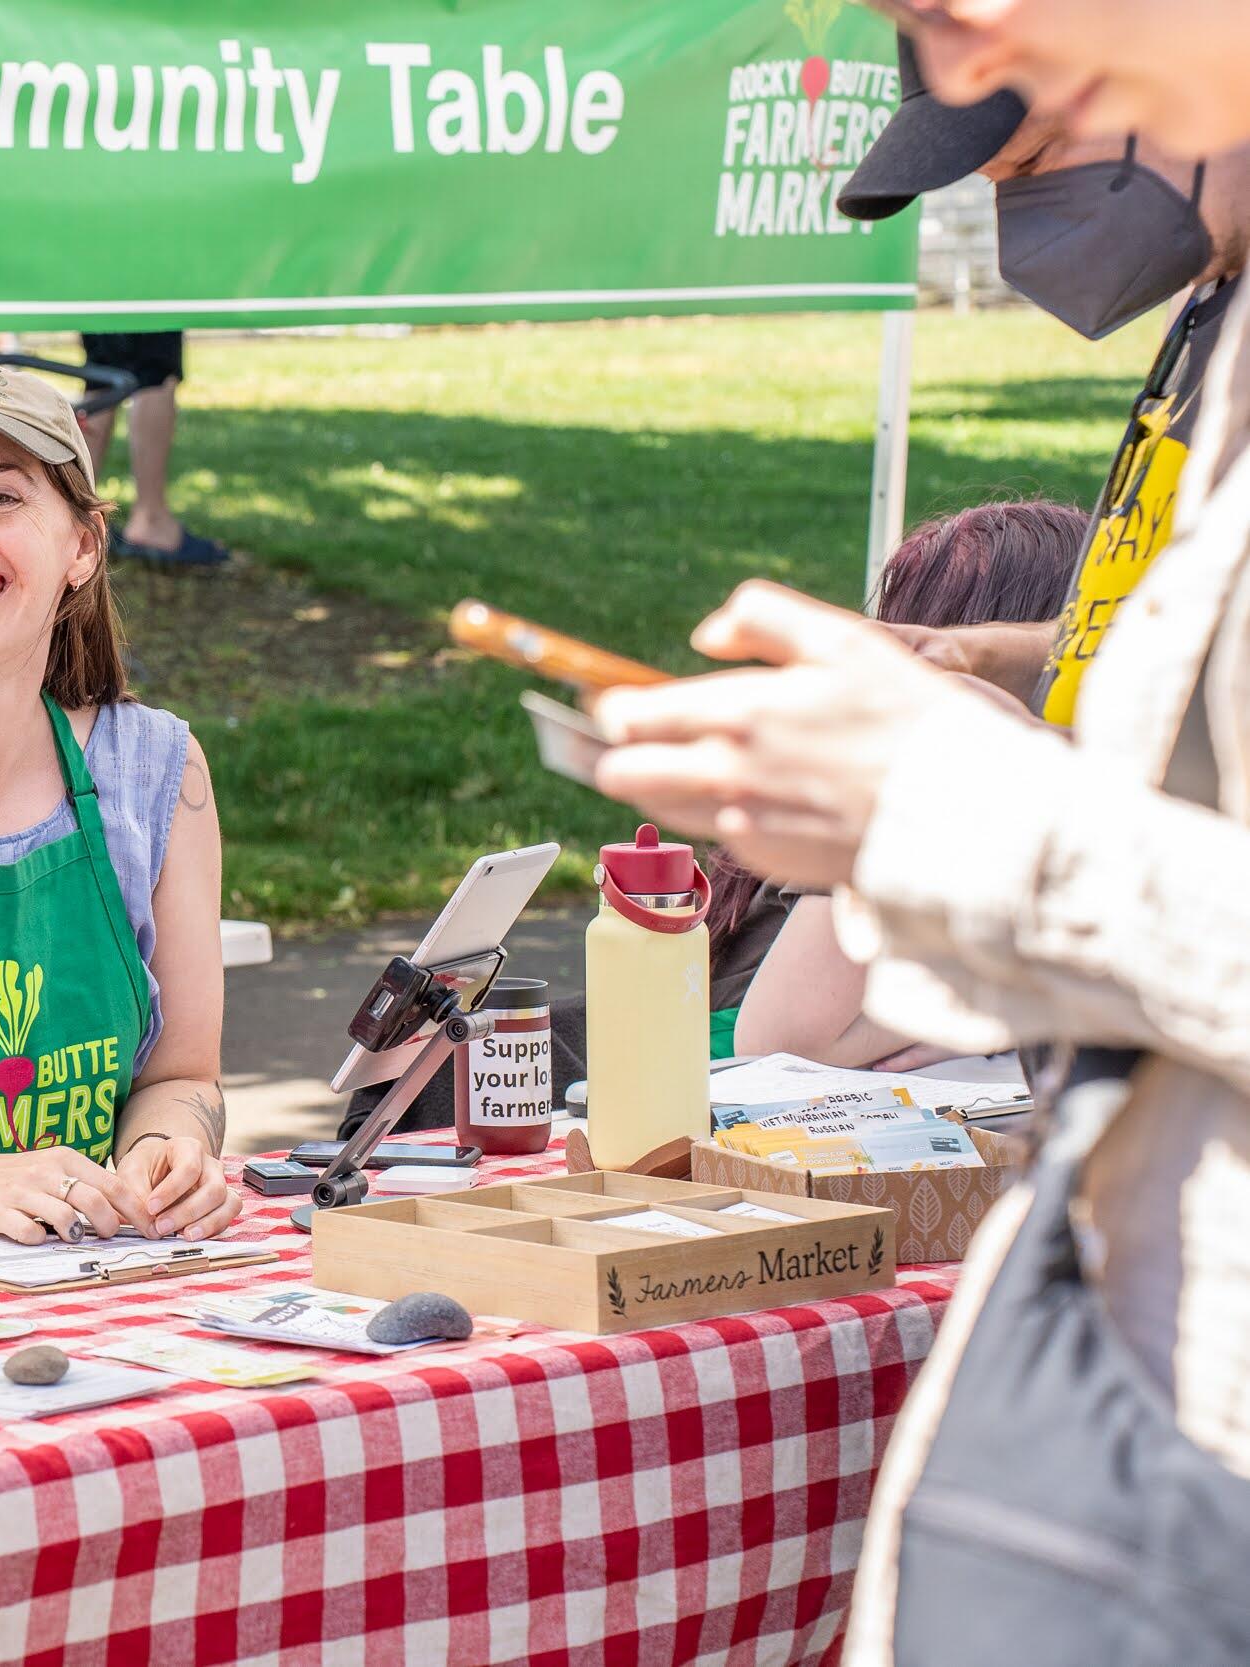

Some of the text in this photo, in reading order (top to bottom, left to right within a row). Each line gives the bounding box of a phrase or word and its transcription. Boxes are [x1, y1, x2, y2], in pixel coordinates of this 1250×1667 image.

[729, 58, 899, 103] ROCKY BUTTE
[365, 42, 625, 156] Table
[715, 170, 874, 237] MARKE
[37, 1036, 119, 1088] BUTTE
[473, 1072, 528, 1091] your
[828, 1092, 873, 1104] ARABIC
[481, 1097, 552, 1118] farmer
[793, 1109, 848, 1124] UKRAINIAN
[808, 1122, 855, 1135] RUSSIAN
[635, 1241, 860, 1304] Farmers Market
